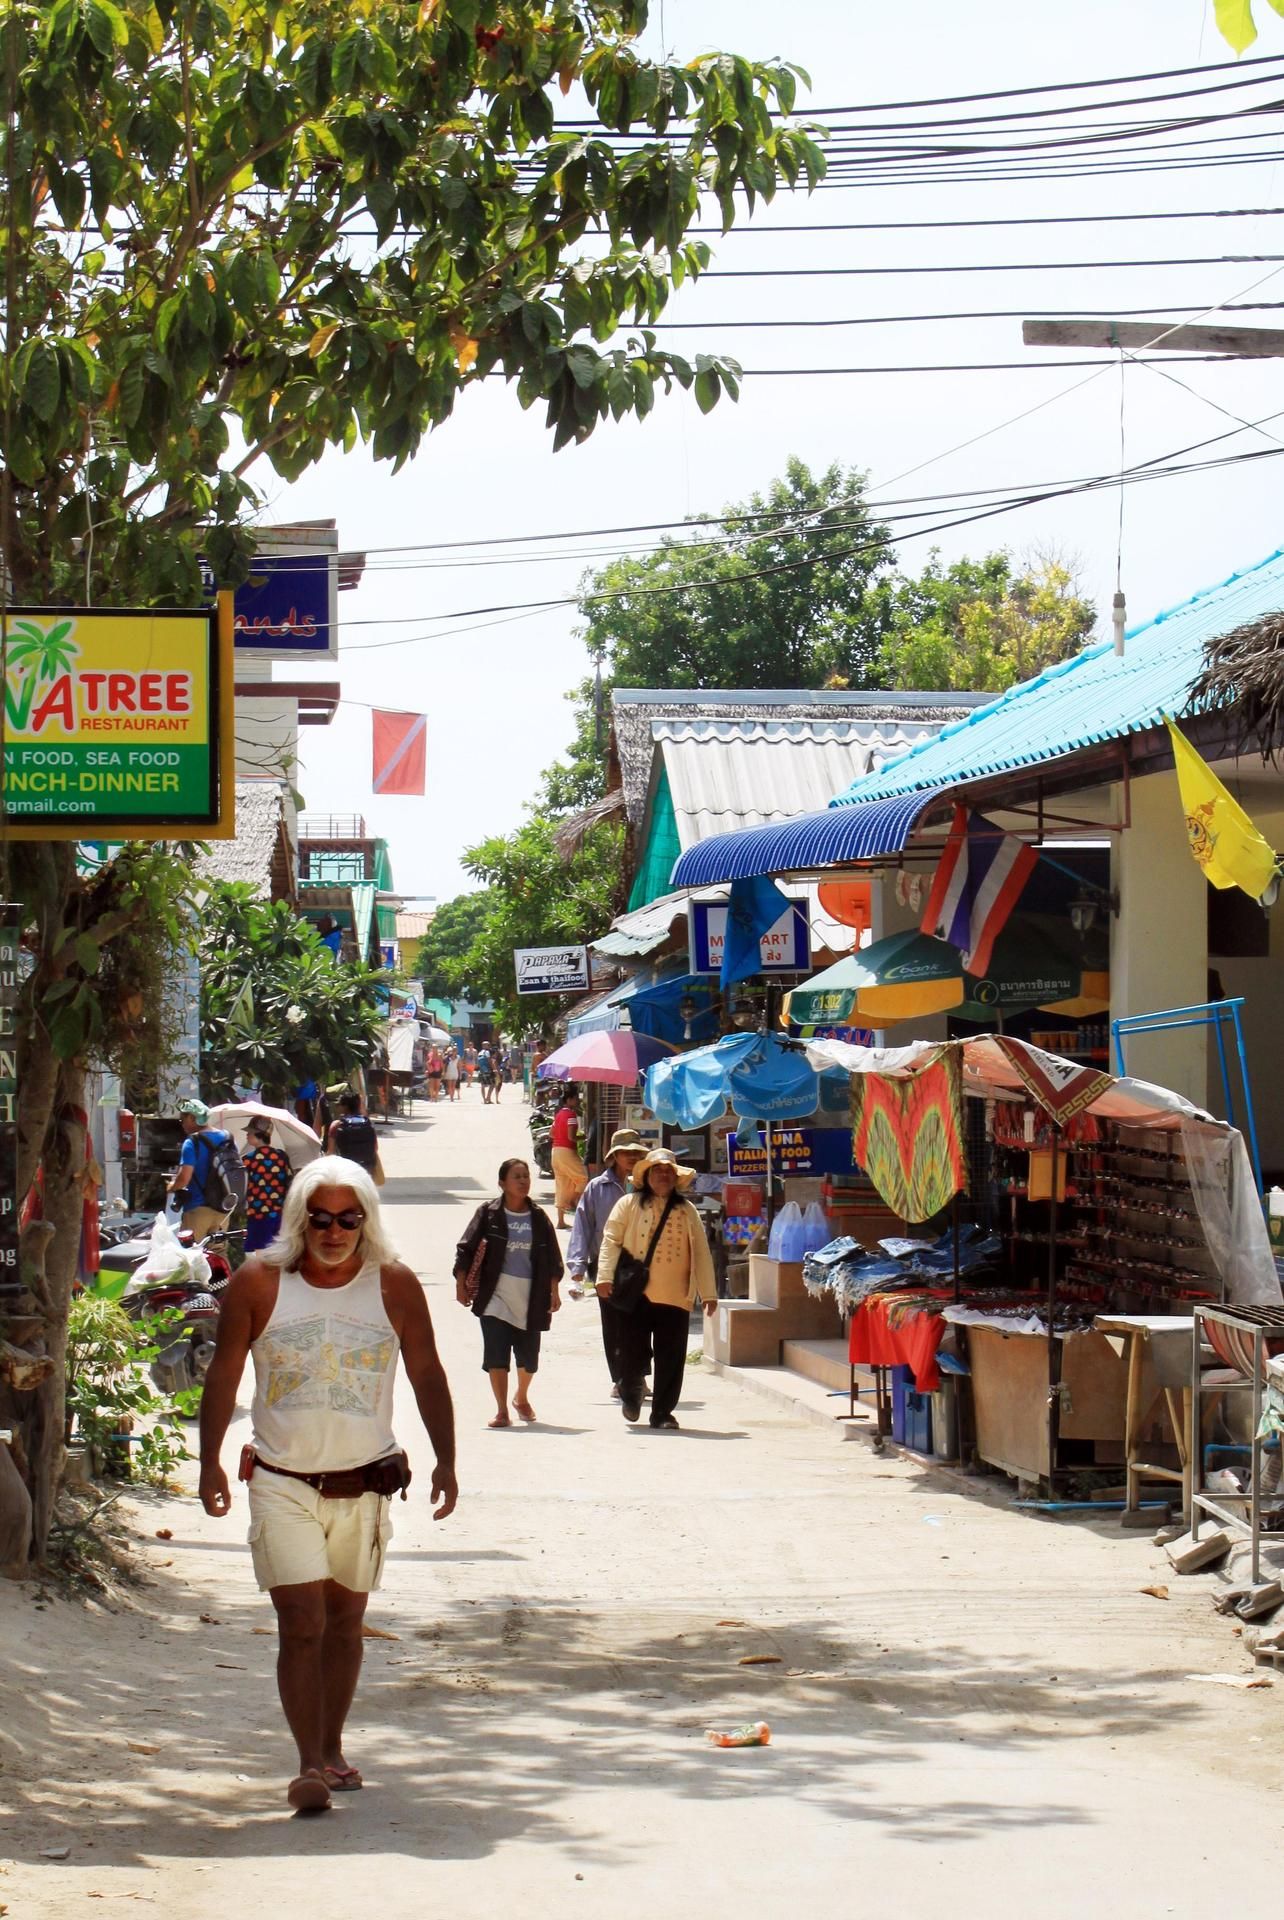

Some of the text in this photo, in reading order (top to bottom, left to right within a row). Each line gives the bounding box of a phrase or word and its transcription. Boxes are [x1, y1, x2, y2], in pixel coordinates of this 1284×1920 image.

[80, 718, 189, 730] RESTAURANT
[22, 752, 78, 766] FOOD,
[86, 752, 121, 765] SEA
[129, 752, 180, 766] FOOD
[3, 799, 95, 814] gmail.com
[519, 953, 570, 976] PAPAYA
[520, 977, 540, 985] Esan
[542, 976, 549, 984] &
[1000, 979, 1071, 991] ธนาคารอิสลาม
[819, 994, 842, 1009] 1302
[781, 1146, 811, 1158] FOOD
[733, 1161, 774, 1173] PIZZER
